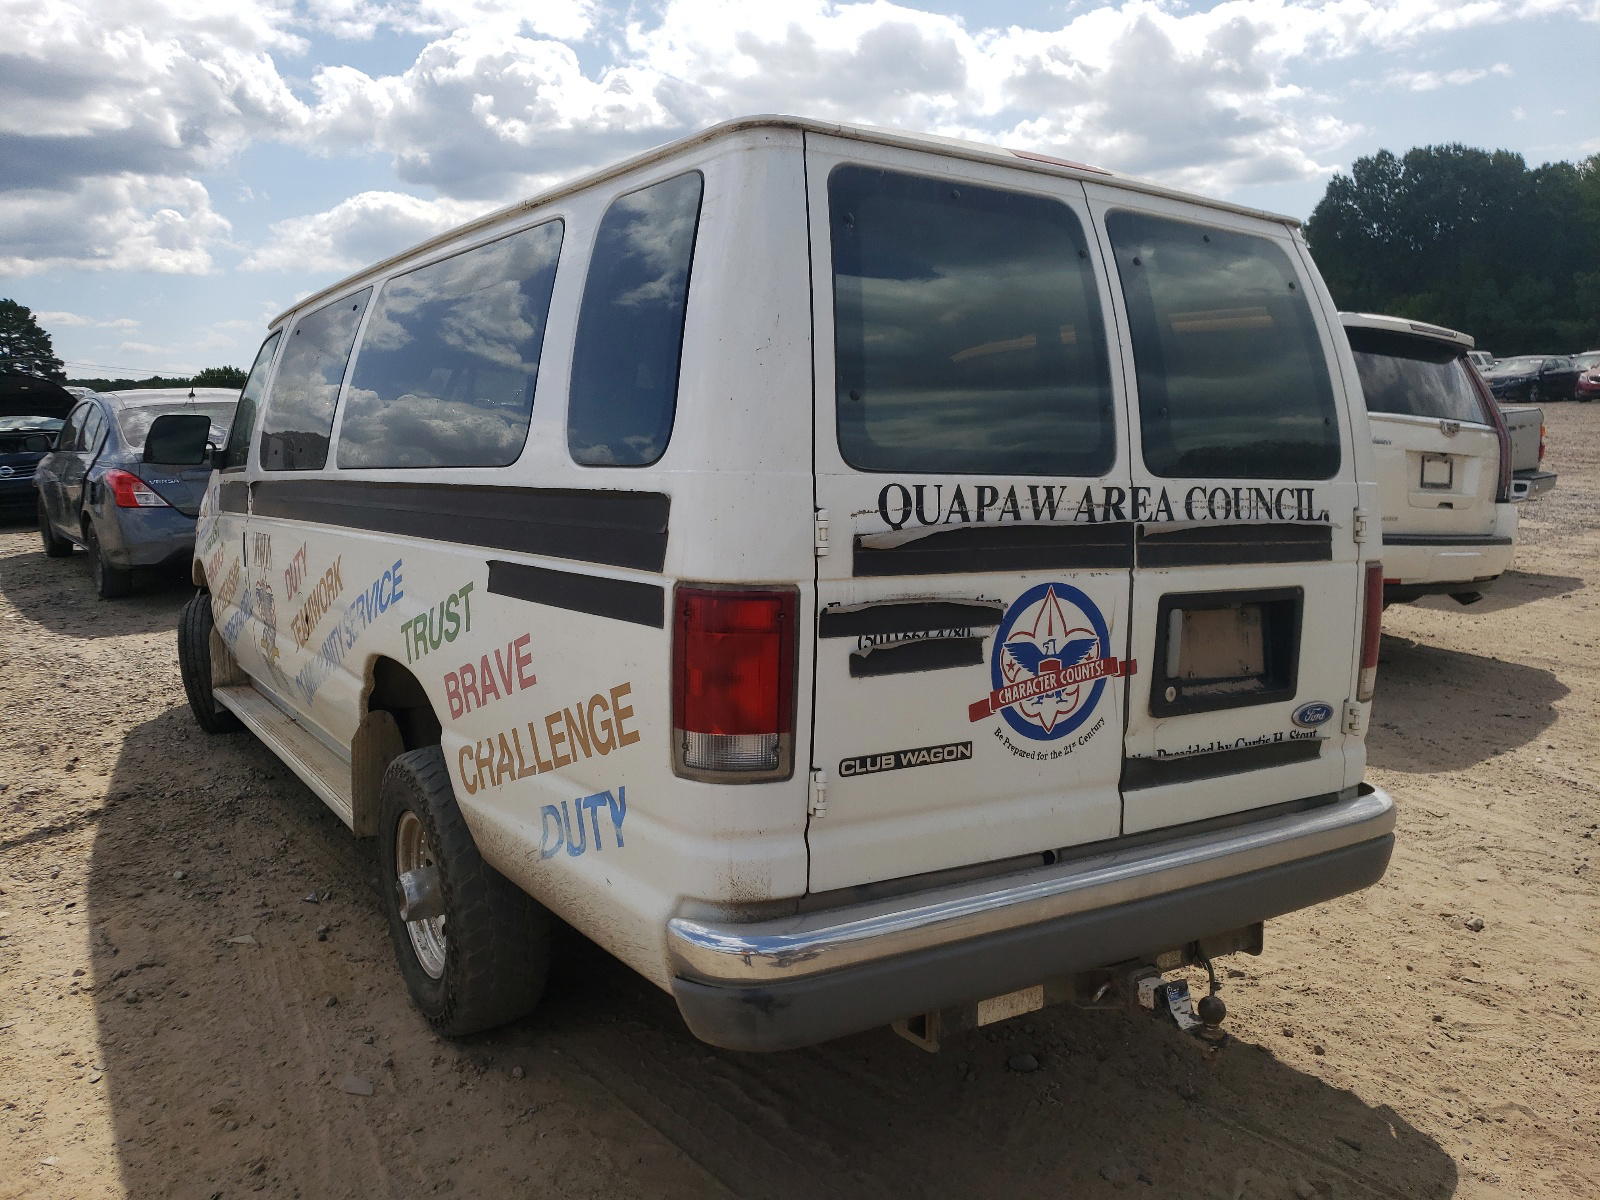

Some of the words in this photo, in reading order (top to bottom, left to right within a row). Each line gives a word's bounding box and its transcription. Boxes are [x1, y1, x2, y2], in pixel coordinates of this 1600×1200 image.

[878, 483, 1067, 531] QUAPAW
[1073, 484, 1175, 522] AREA
[284, 541, 307, 601] DUTY
[343, 558, 404, 650] SERVICE
[400, 581, 474, 665] TRUST
[443, 633, 537, 720] BRAVE
[998, 674, 1057, 704] CHARACTER
[1060, 660, 1104, 684] COUNTS!
[458, 682, 641, 795] CHALLENGE
[840, 754, 895, 776] CLUB
[900, 743, 972, 766] WAGON
[994, 727, 1004, 741] Be
[1003, 738, 1035, 760] Prepared
[1037, 750, 1048, 760] for
[1050, 749, 1062, 760] the
[1078, 717, 1105, 746] Century
[539, 785, 627, 860] DUTY
